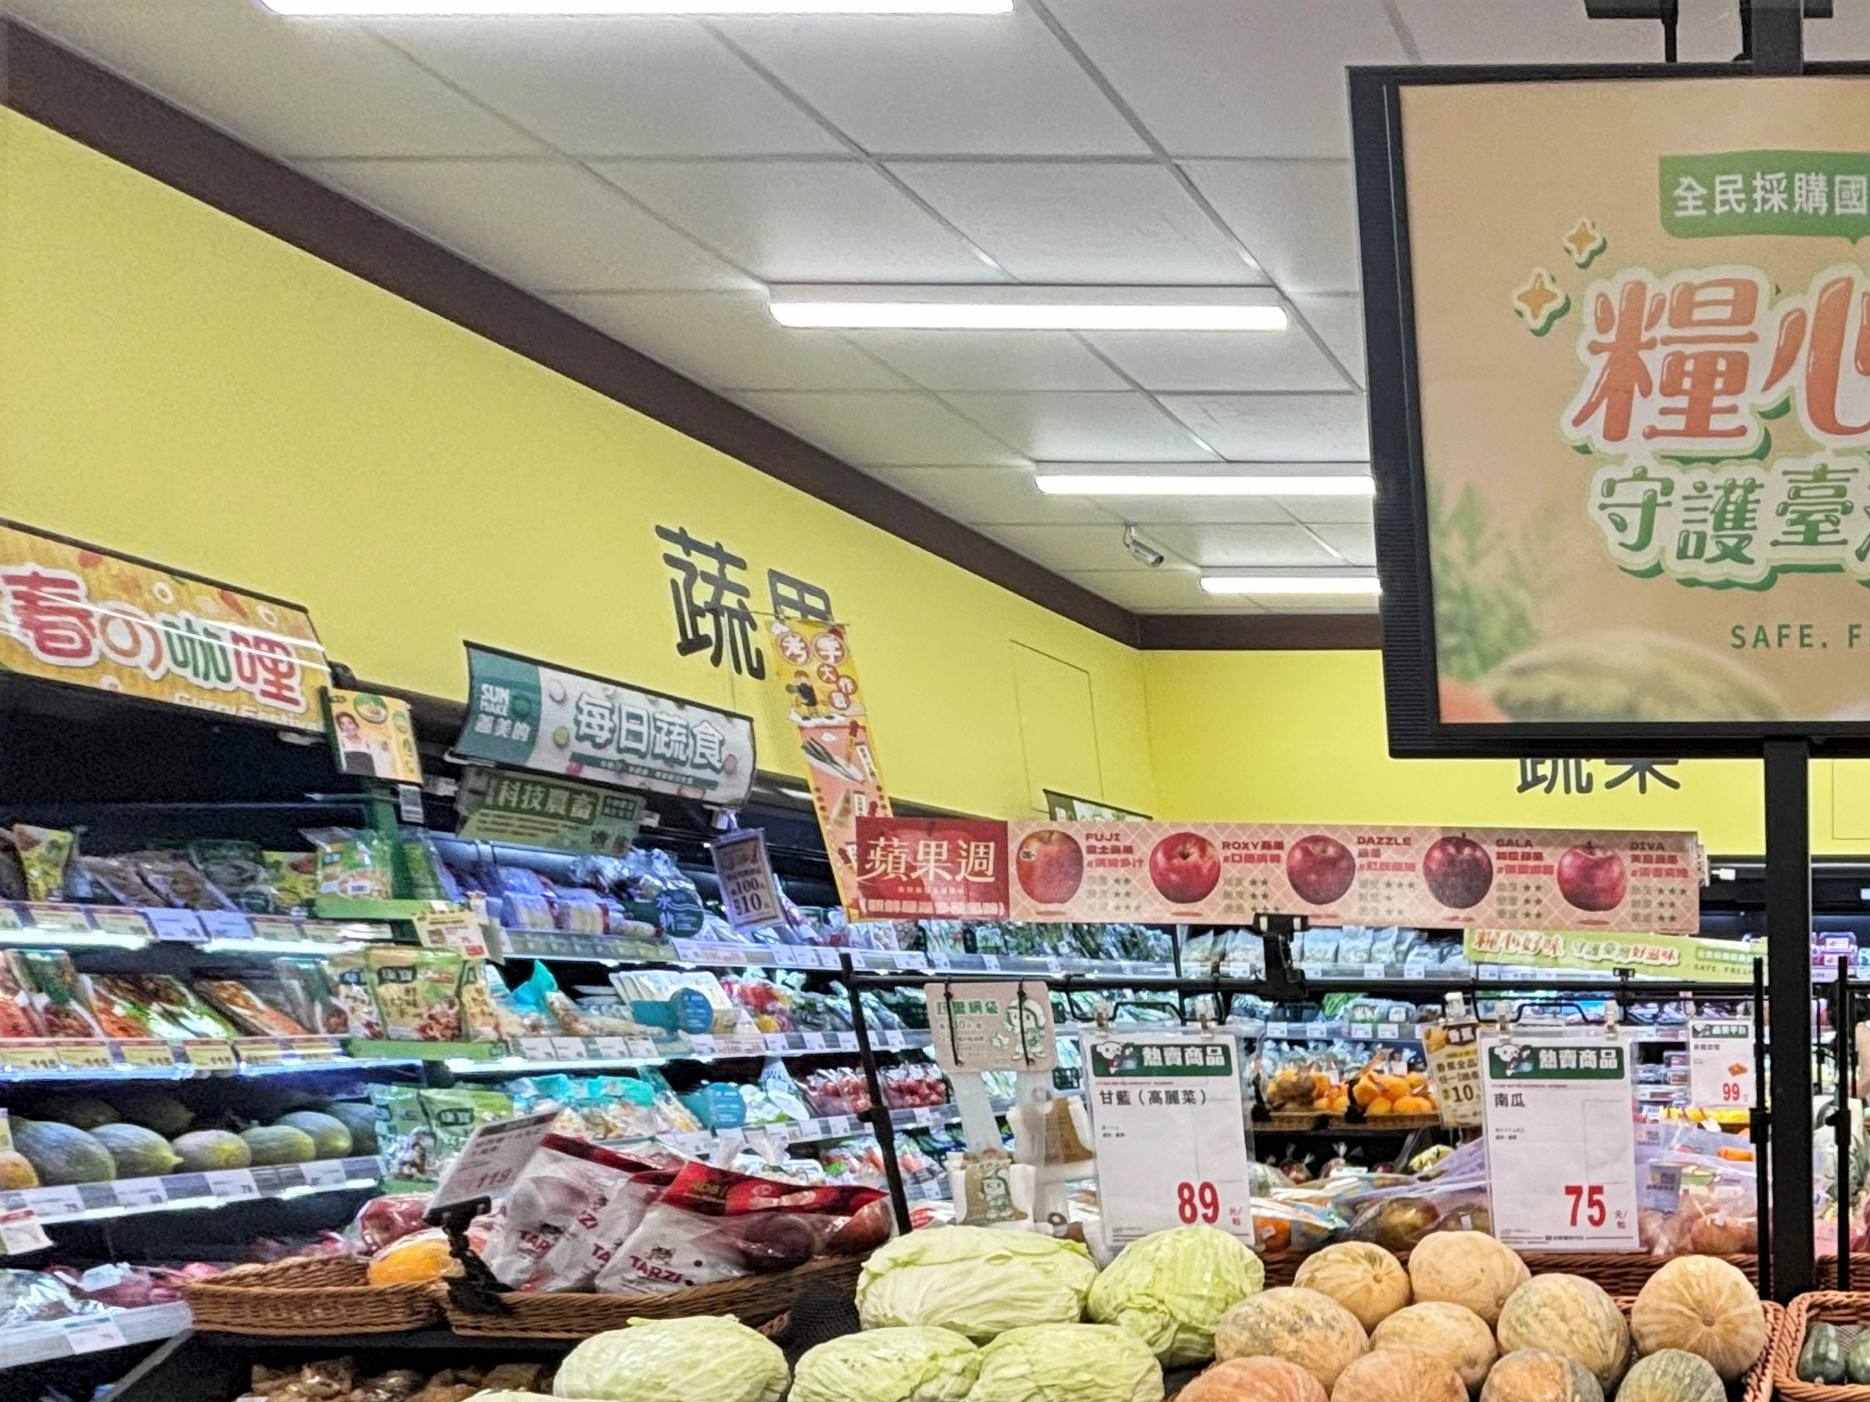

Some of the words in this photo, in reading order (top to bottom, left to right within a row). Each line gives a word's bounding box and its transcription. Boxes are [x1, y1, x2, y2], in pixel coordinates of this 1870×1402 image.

[1, 570, 301, 707] 春の咖哩
[1730, 621, 1829, 650] SAFE.
[867, 838, 996, 885] 蘋果週
[1141, 1045, 1226, 1067] 熱賣商品
[1538, 1049, 1618, 1070] 熱賣商品
[1451, 1083, 1474, 1103] 10
[1493, 1092, 1526, 1109] 南瓜
[1722, 1082, 1741, 1102] 99
[1177, 1181, 1221, 1225] 89
[1564, 1184, 1607, 1229] 75
